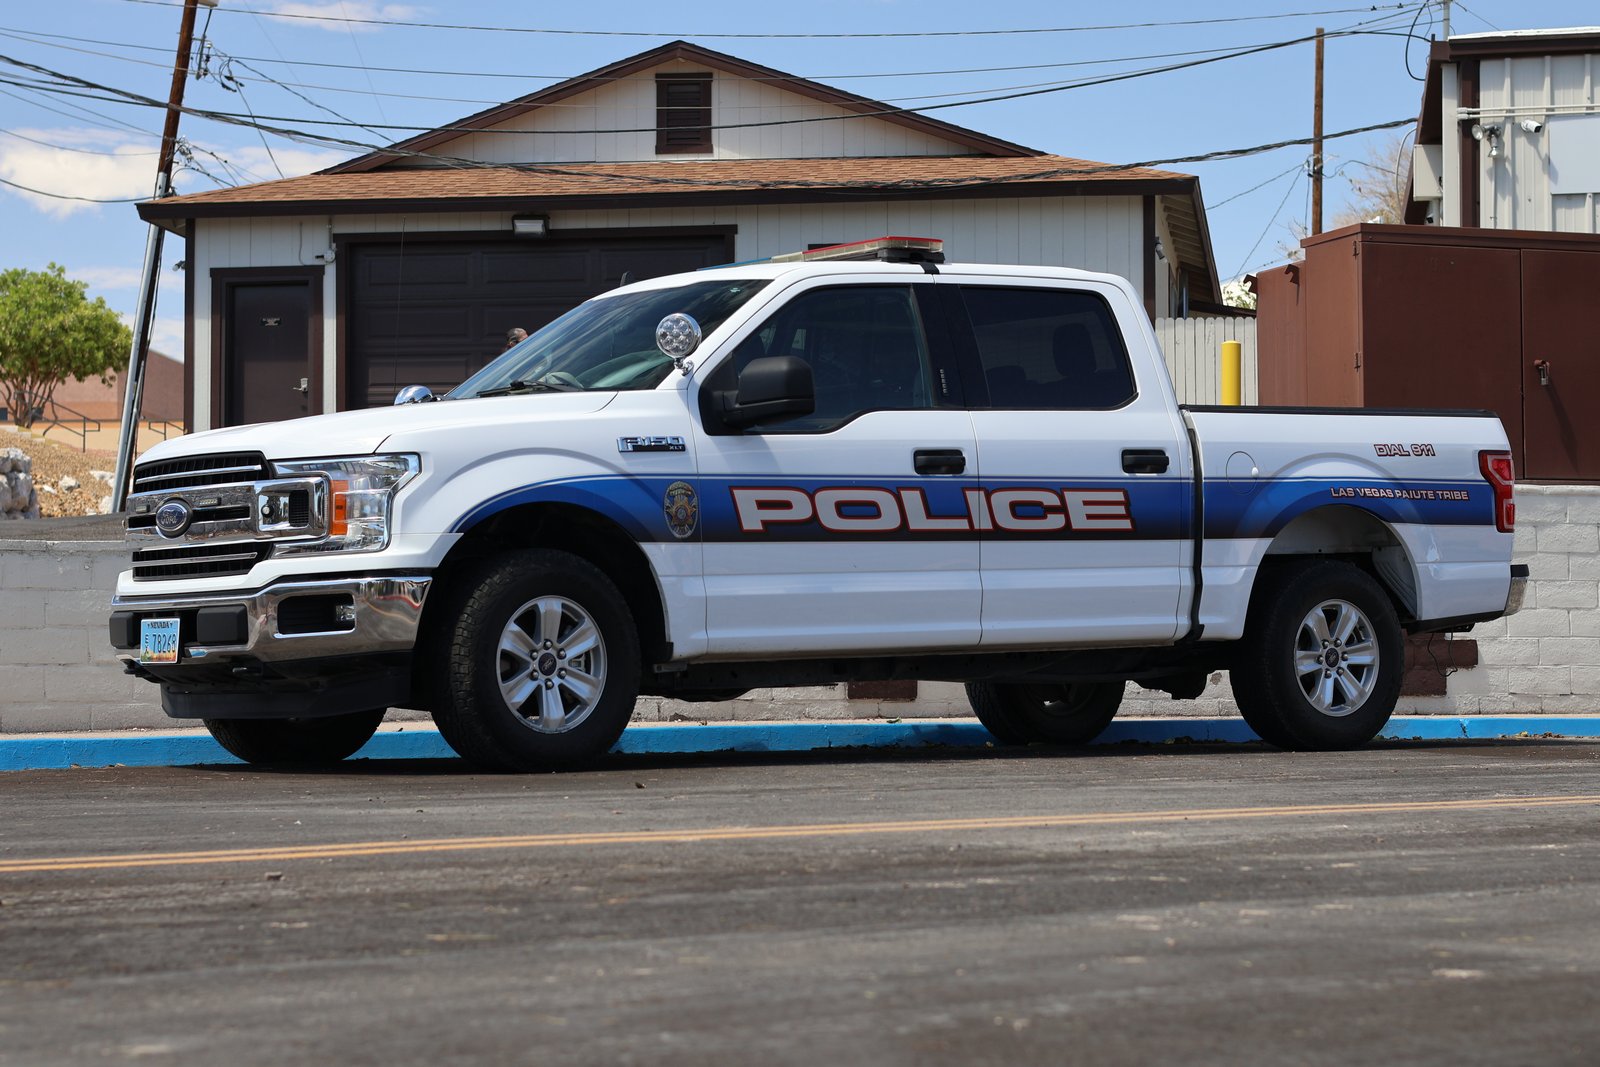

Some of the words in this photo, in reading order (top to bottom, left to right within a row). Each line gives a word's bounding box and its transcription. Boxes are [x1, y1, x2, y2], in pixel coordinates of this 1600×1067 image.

[1374, 444, 1410, 456] DIAL
[1411, 444, 1436, 456] 911
[1330, 487, 1355, 498] LAS
[1356, 487, 1394, 499] VEGAS
[1394, 489, 1435, 500] PAIUTE
[1436, 490, 1469, 500] TRIBE
[729, 486, 1135, 532] POLICE
[150, 621, 170, 629] NEVADA
